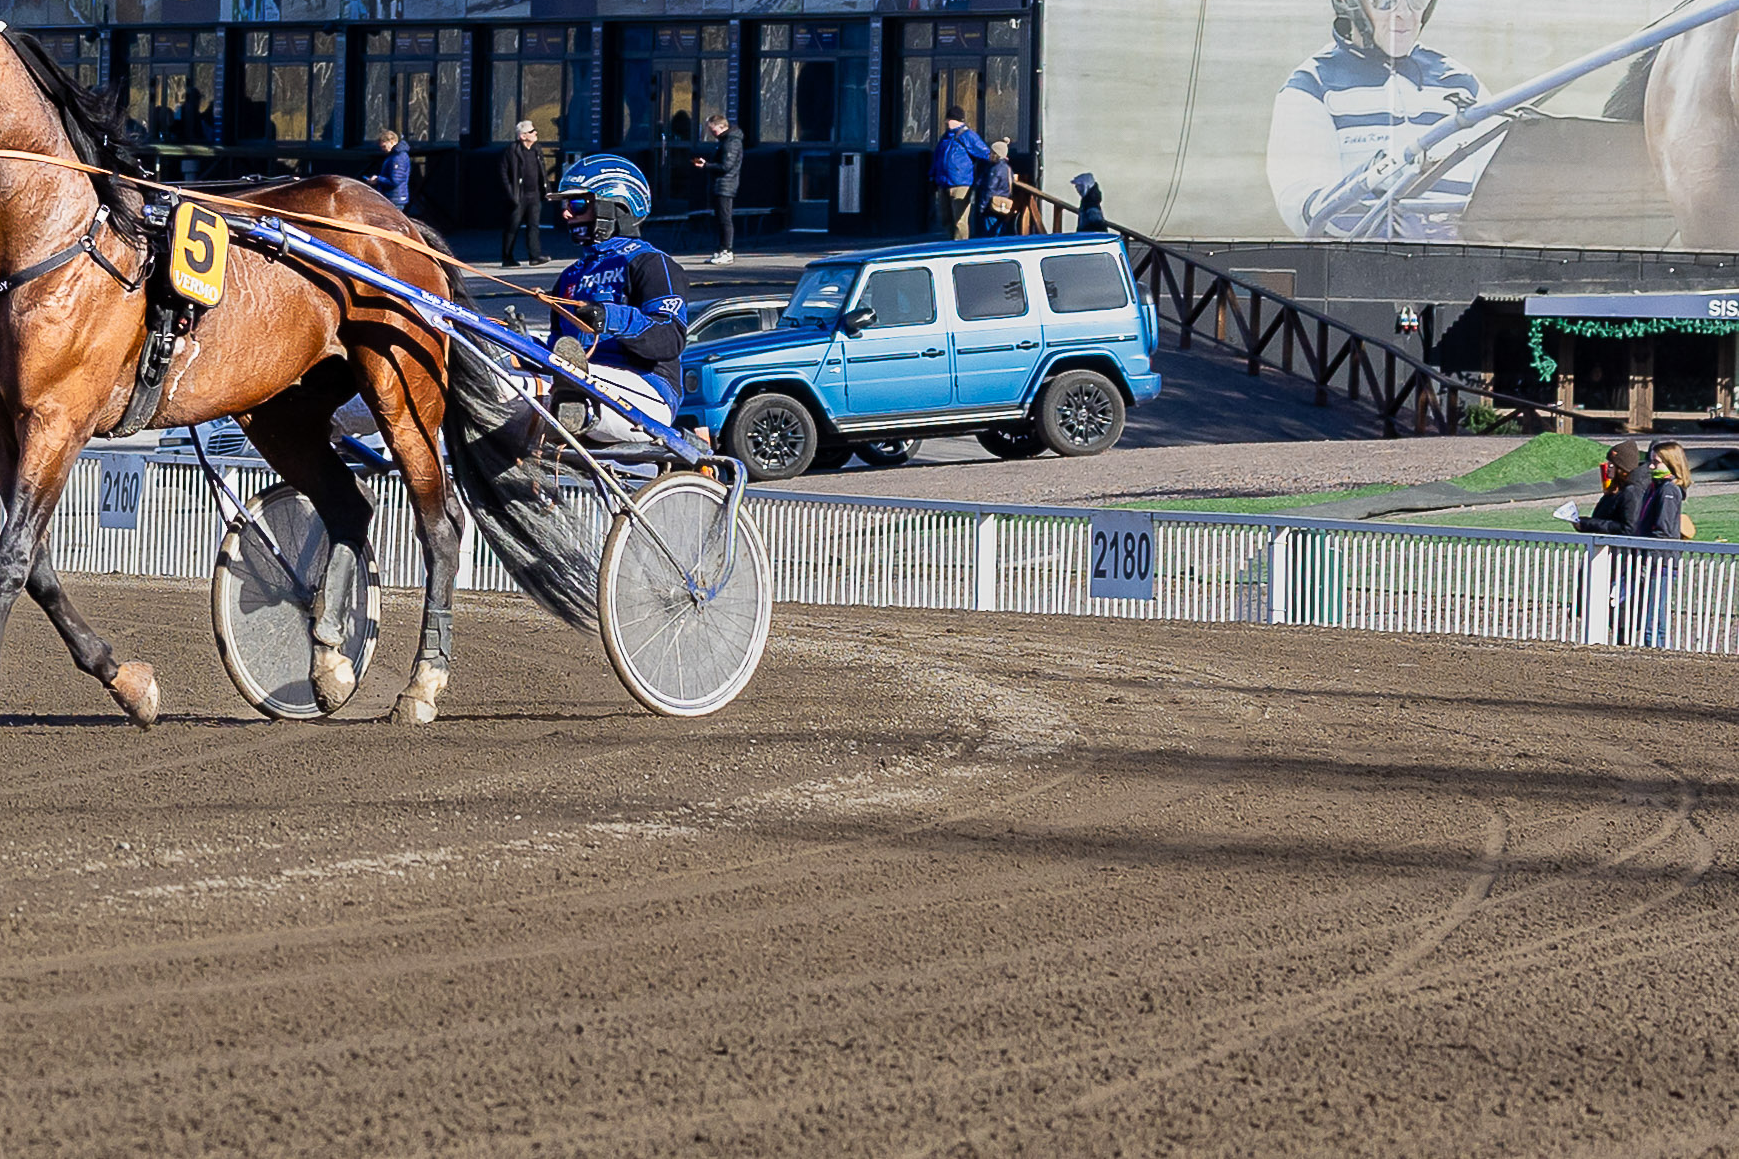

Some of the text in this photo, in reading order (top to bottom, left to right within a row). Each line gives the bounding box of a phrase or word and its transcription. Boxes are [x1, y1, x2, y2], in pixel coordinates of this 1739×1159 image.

[184, 206, 217, 274] 5
[174, 270, 219, 302] VERMO
[1708, 299, 1739, 317] SIS
[102, 470, 140, 514] 2160
[1093, 530, 1151, 581] 2180
